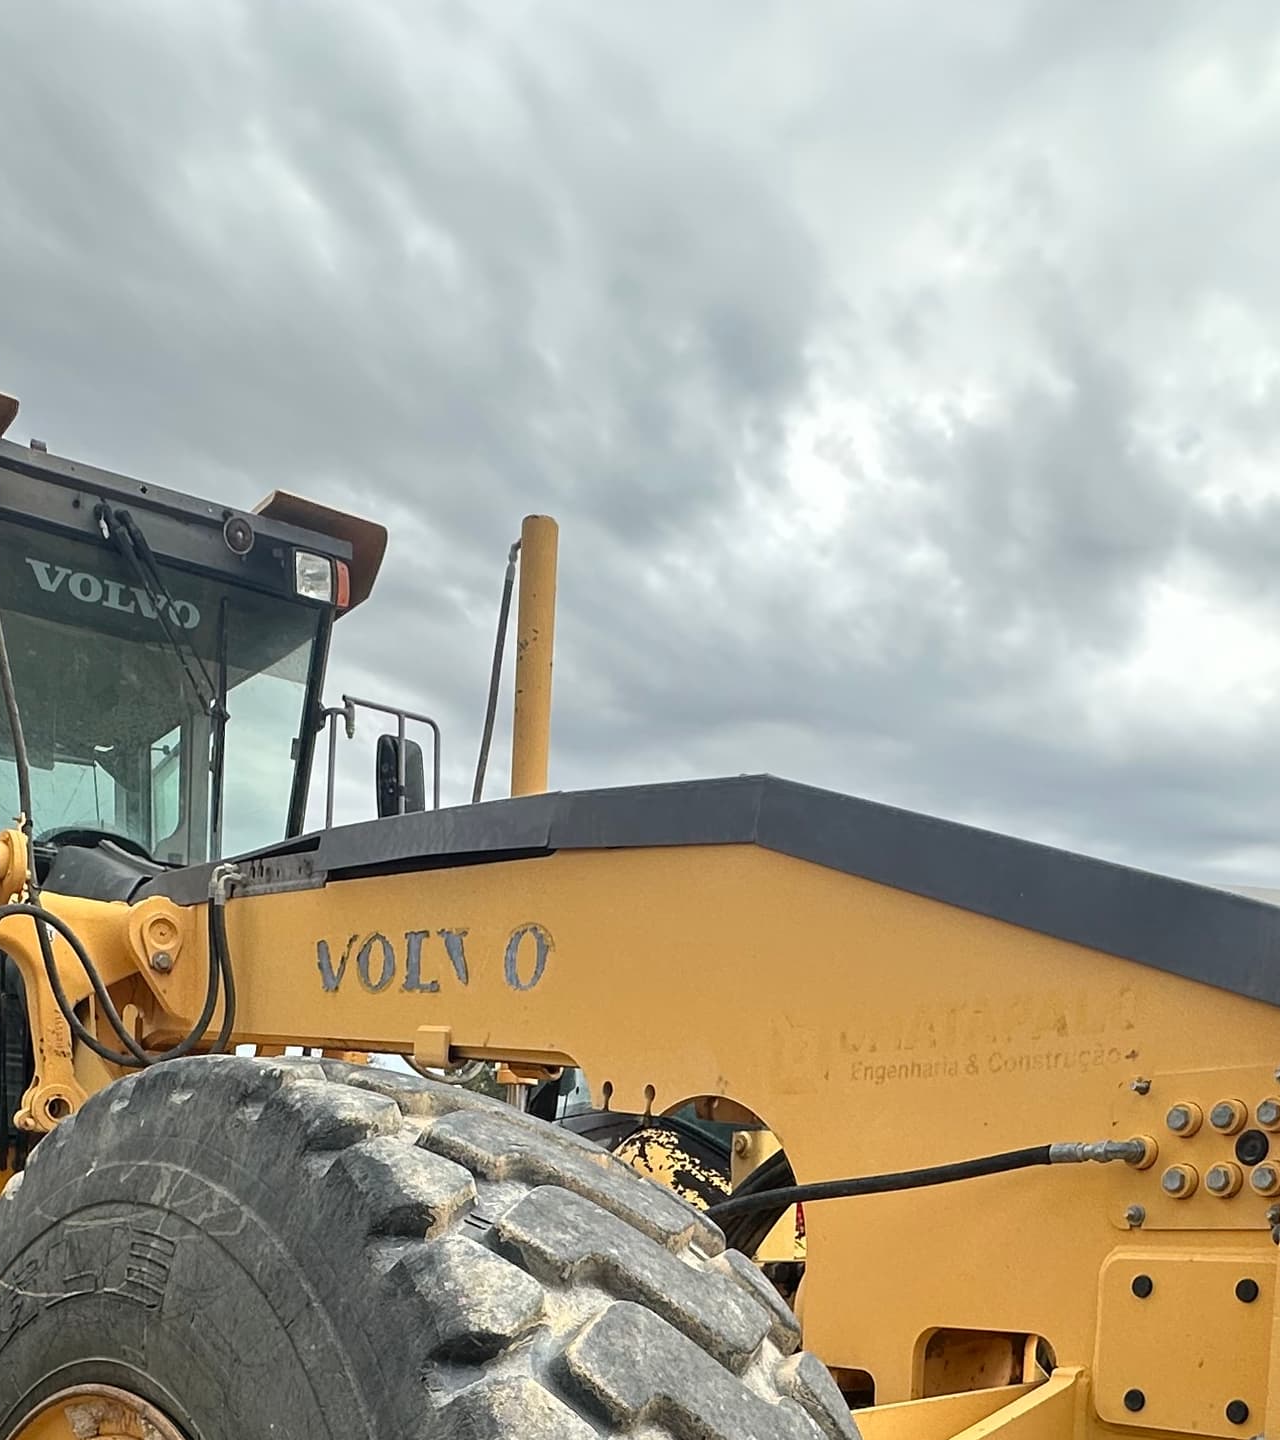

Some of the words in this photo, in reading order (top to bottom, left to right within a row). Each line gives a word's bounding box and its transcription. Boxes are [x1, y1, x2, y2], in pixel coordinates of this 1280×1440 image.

[25, 557, 200, 629] VOLVO
[849, 1059, 959, 1085] Engenharia
[965, 1054, 980, 1077] &
[988, 1043, 1122, 1074] Construção
